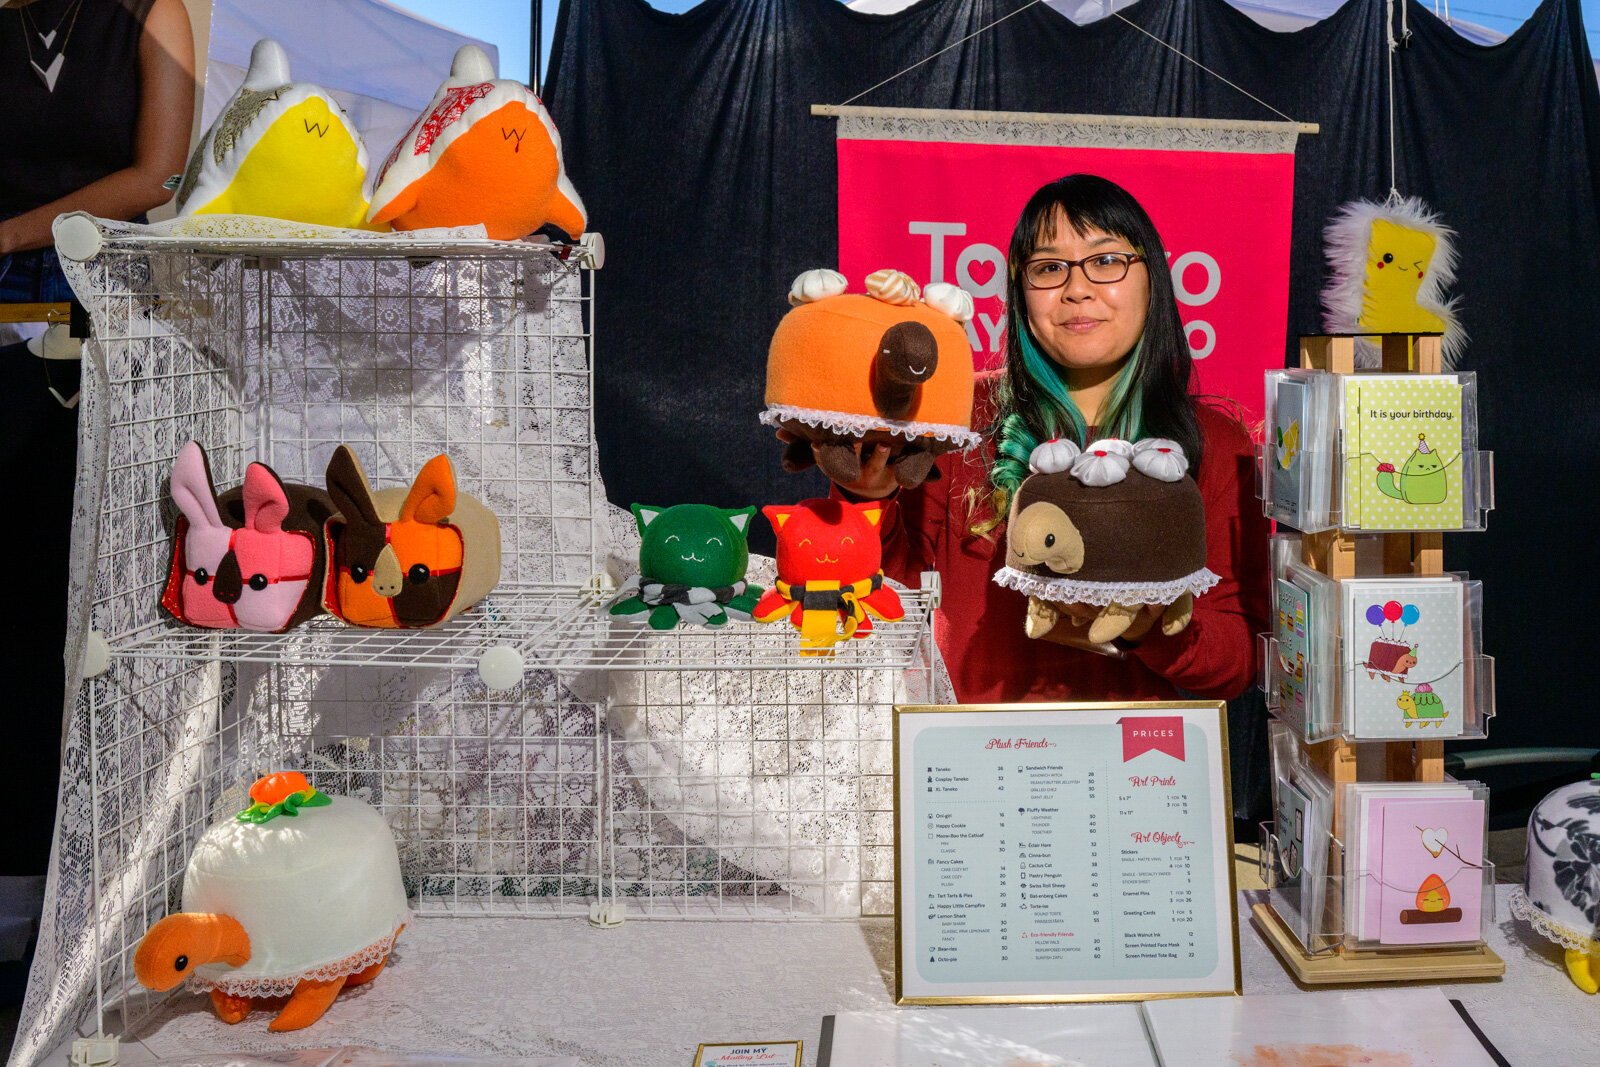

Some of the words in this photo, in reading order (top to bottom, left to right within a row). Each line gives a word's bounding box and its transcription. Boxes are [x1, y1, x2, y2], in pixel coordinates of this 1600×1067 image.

[1370, 410, 1377, 418] It
[1380, 410, 1387, 418] is
[1389, 411, 1411, 420] your
[1413, 409, 1454, 420] birthday.
[985, 738, 1011, 749] Plush
[1014, 738, 1048, 749] Friends
[1128, 776, 1148, 788] Art
[1150, 776, 1176, 787] Prints
[1130, 831, 1151, 844] Art
[1153, 831, 1183, 848] Objects
